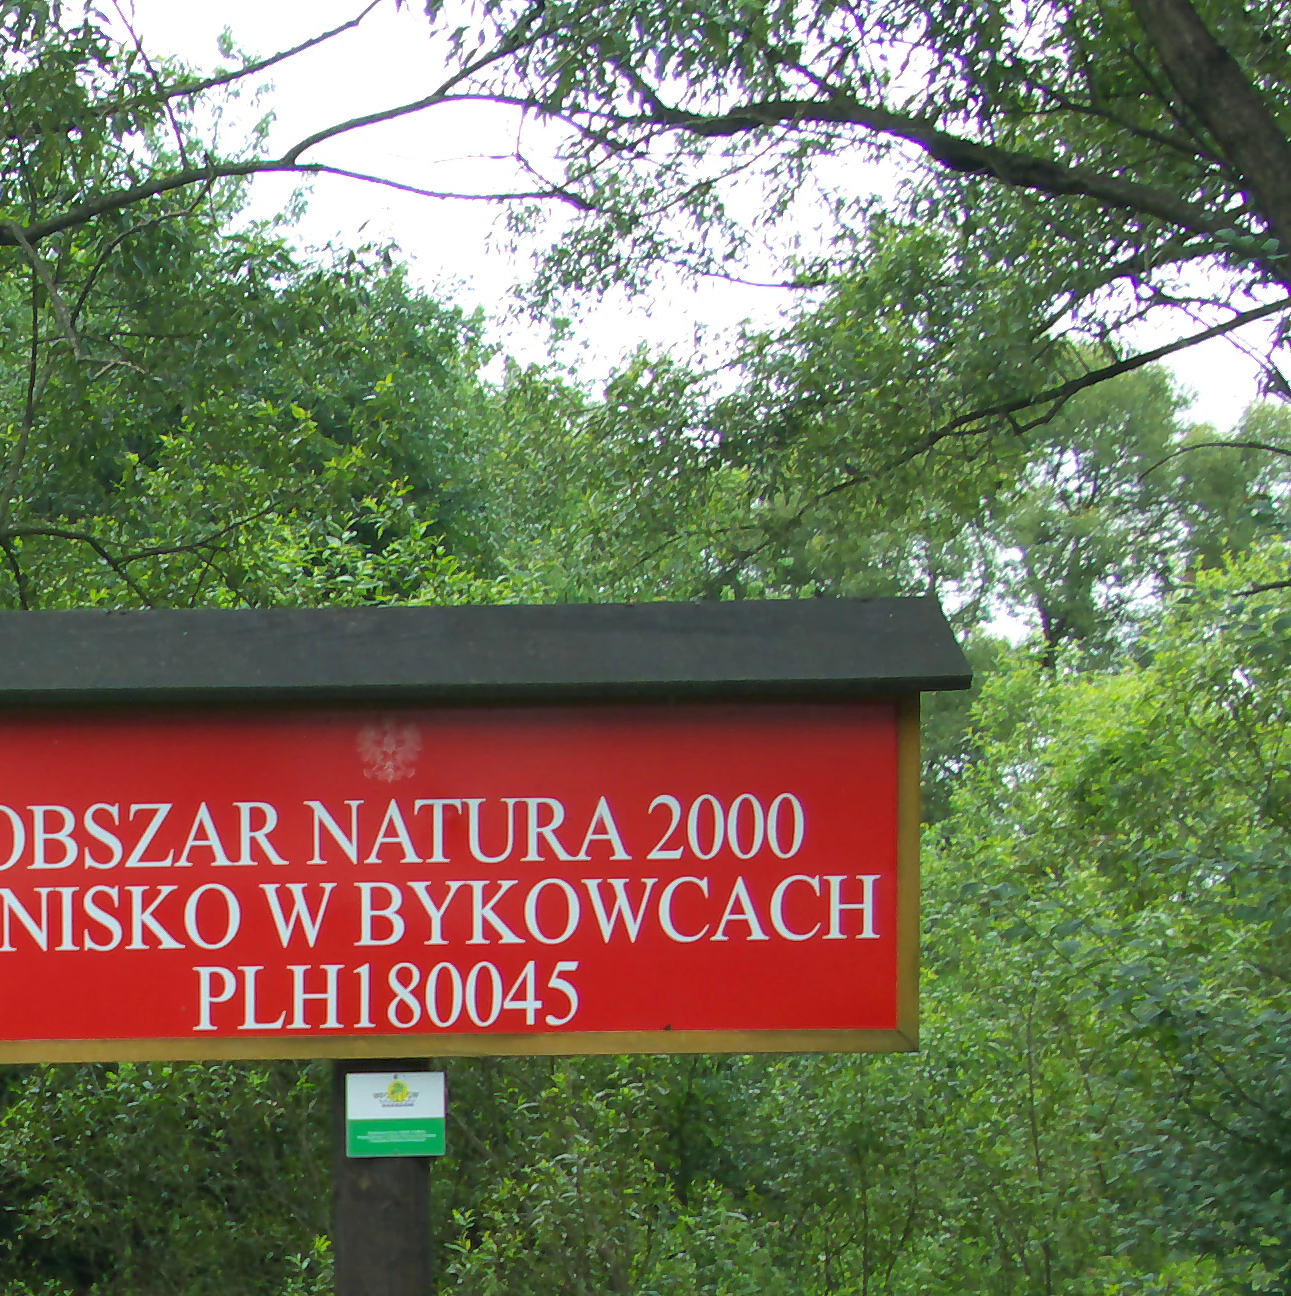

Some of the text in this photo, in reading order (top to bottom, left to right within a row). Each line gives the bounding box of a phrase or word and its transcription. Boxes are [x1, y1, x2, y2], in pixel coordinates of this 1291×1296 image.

[302, 795, 633, 865] NATURA
[646, 792, 805, 860] 2000
[258, 882, 338, 949] W
[353, 873, 882, 947] BYKOWCACH
[191, 960, 579, 1031] PLH180045
